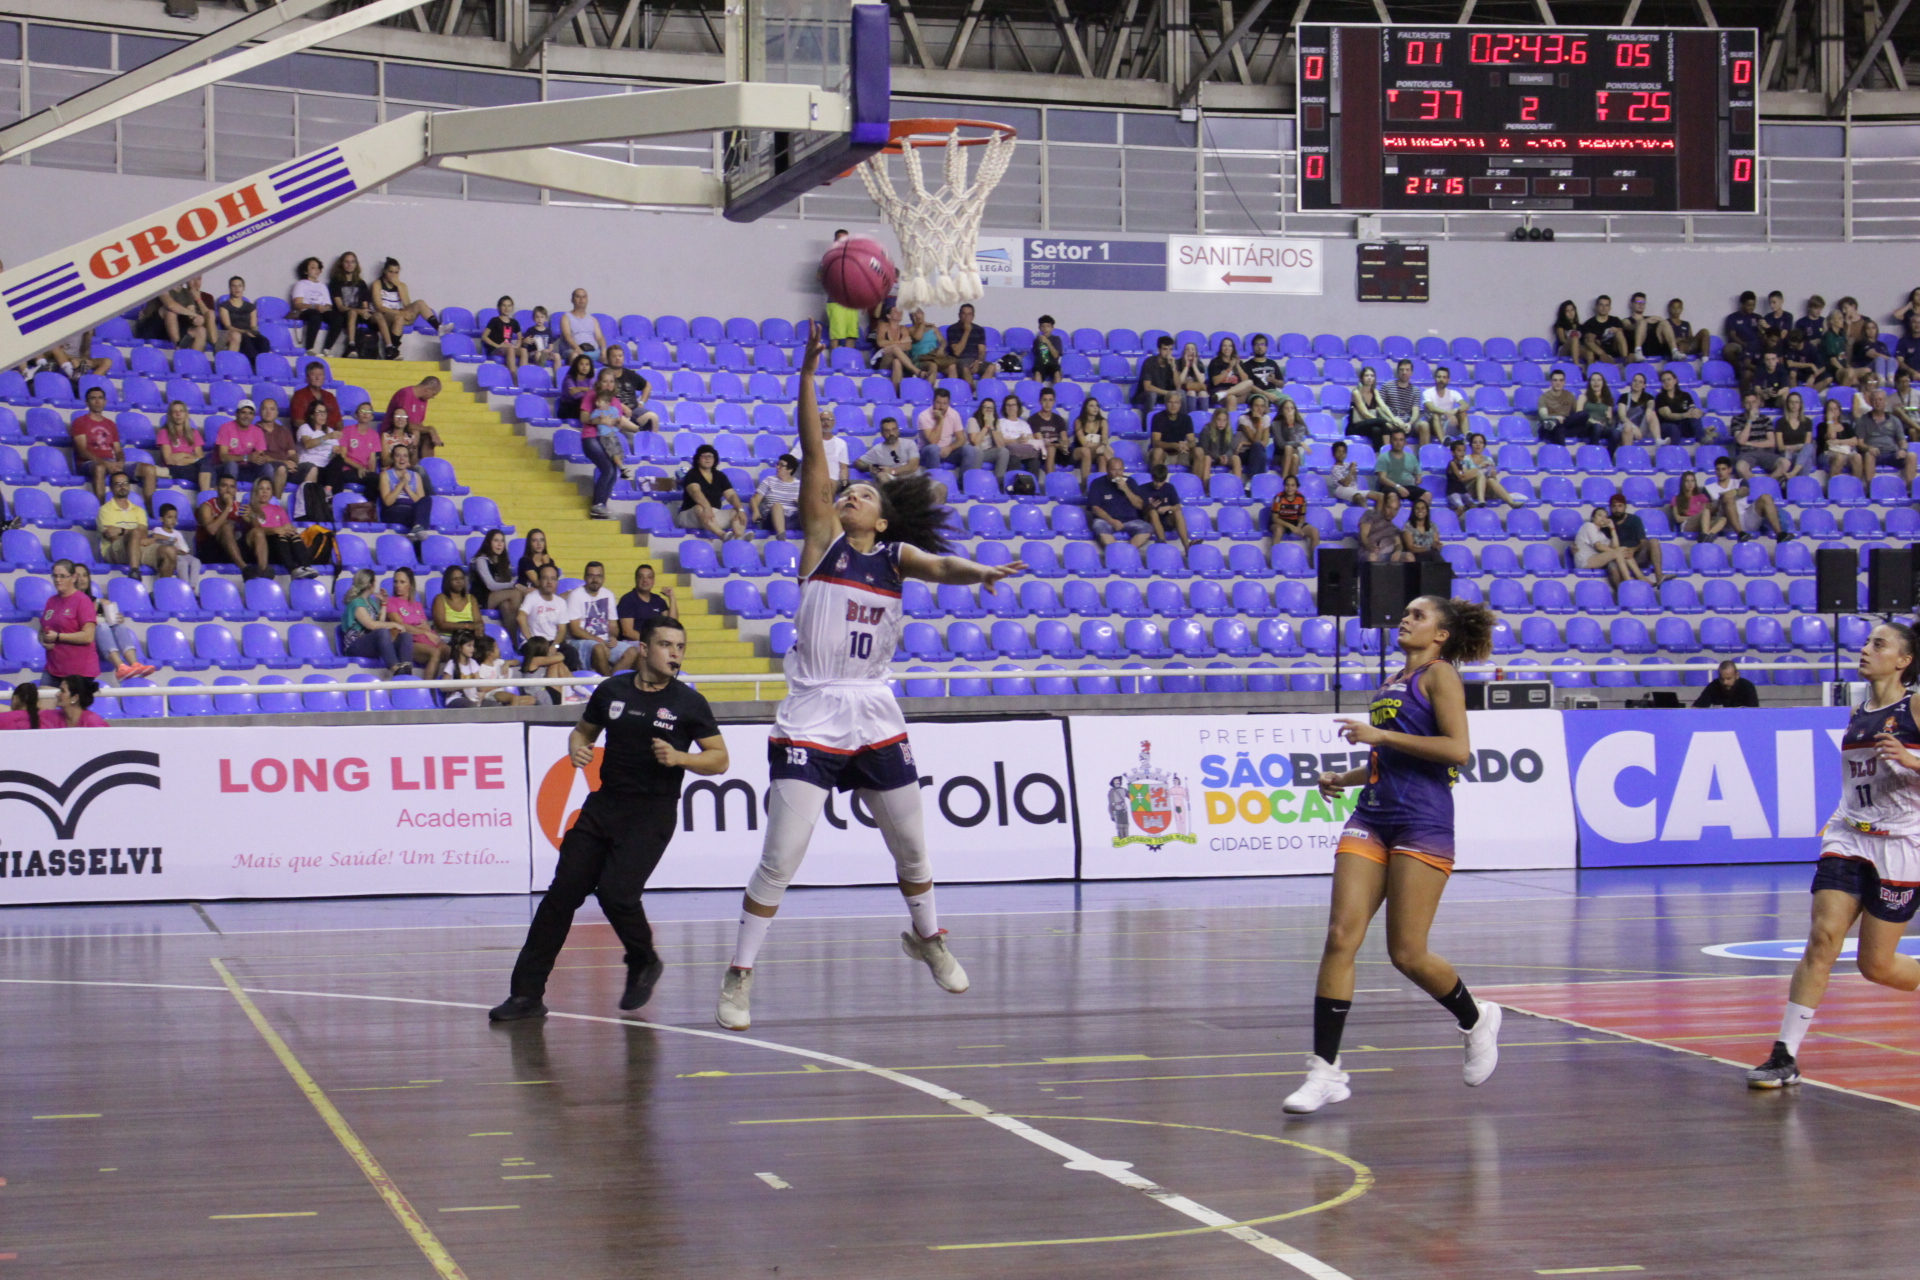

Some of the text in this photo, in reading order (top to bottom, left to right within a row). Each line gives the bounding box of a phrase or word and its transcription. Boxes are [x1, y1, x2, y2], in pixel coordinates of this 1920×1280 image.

[1382, 28, 1390, 62] FALTAS
[1397, 31, 1451, 40] FALTAS/SETS
[1606, 34, 1660, 42] FALTAS/SETS
[1406, 41, 1443, 65] 01
[1616, 43, 1651, 67] 05
[1305, 55, 1324, 80] 0
[1733, 60, 1751, 84] 0
[1395, 80, 1453, 89] PONTOS/GOLS
[1605, 82, 1662, 90] PONTOS/GOLS
[1420, 90, 1463, 120] 37
[1521, 97, 1539, 121] 2
[1627, 91, 1671, 122] 25
[1305, 155, 1325, 179] 0
[1733, 158, 1752, 182] 0
[1406, 177, 1432, 194] 21
[1445, 177, 1464, 195] 15
[89, 183, 268, 280] GROH
[226, 217, 276, 244] BASKETBALL
[1030, 240, 1110, 261] Setor 1
[1179, 242, 1314, 268] SANITÁRIOS
[1030, 263, 1051, 271] Sector
[846, 598, 886, 626] BLU
[849, 630, 873, 660] 10
[219, 755, 506, 793] LONG LIFE
[1847, 756, 1878, 779] BLU
[1855, 783, 1874, 808] 11
[396, 808, 513, 828] Academia
[1209, 836, 1272, 851] CIDADE
[1277, 836, 1303, 850] DO
[231, 847, 511, 873] Mais que Saúde! Um Estilo...
[1880, 886, 1914, 907] BLU
